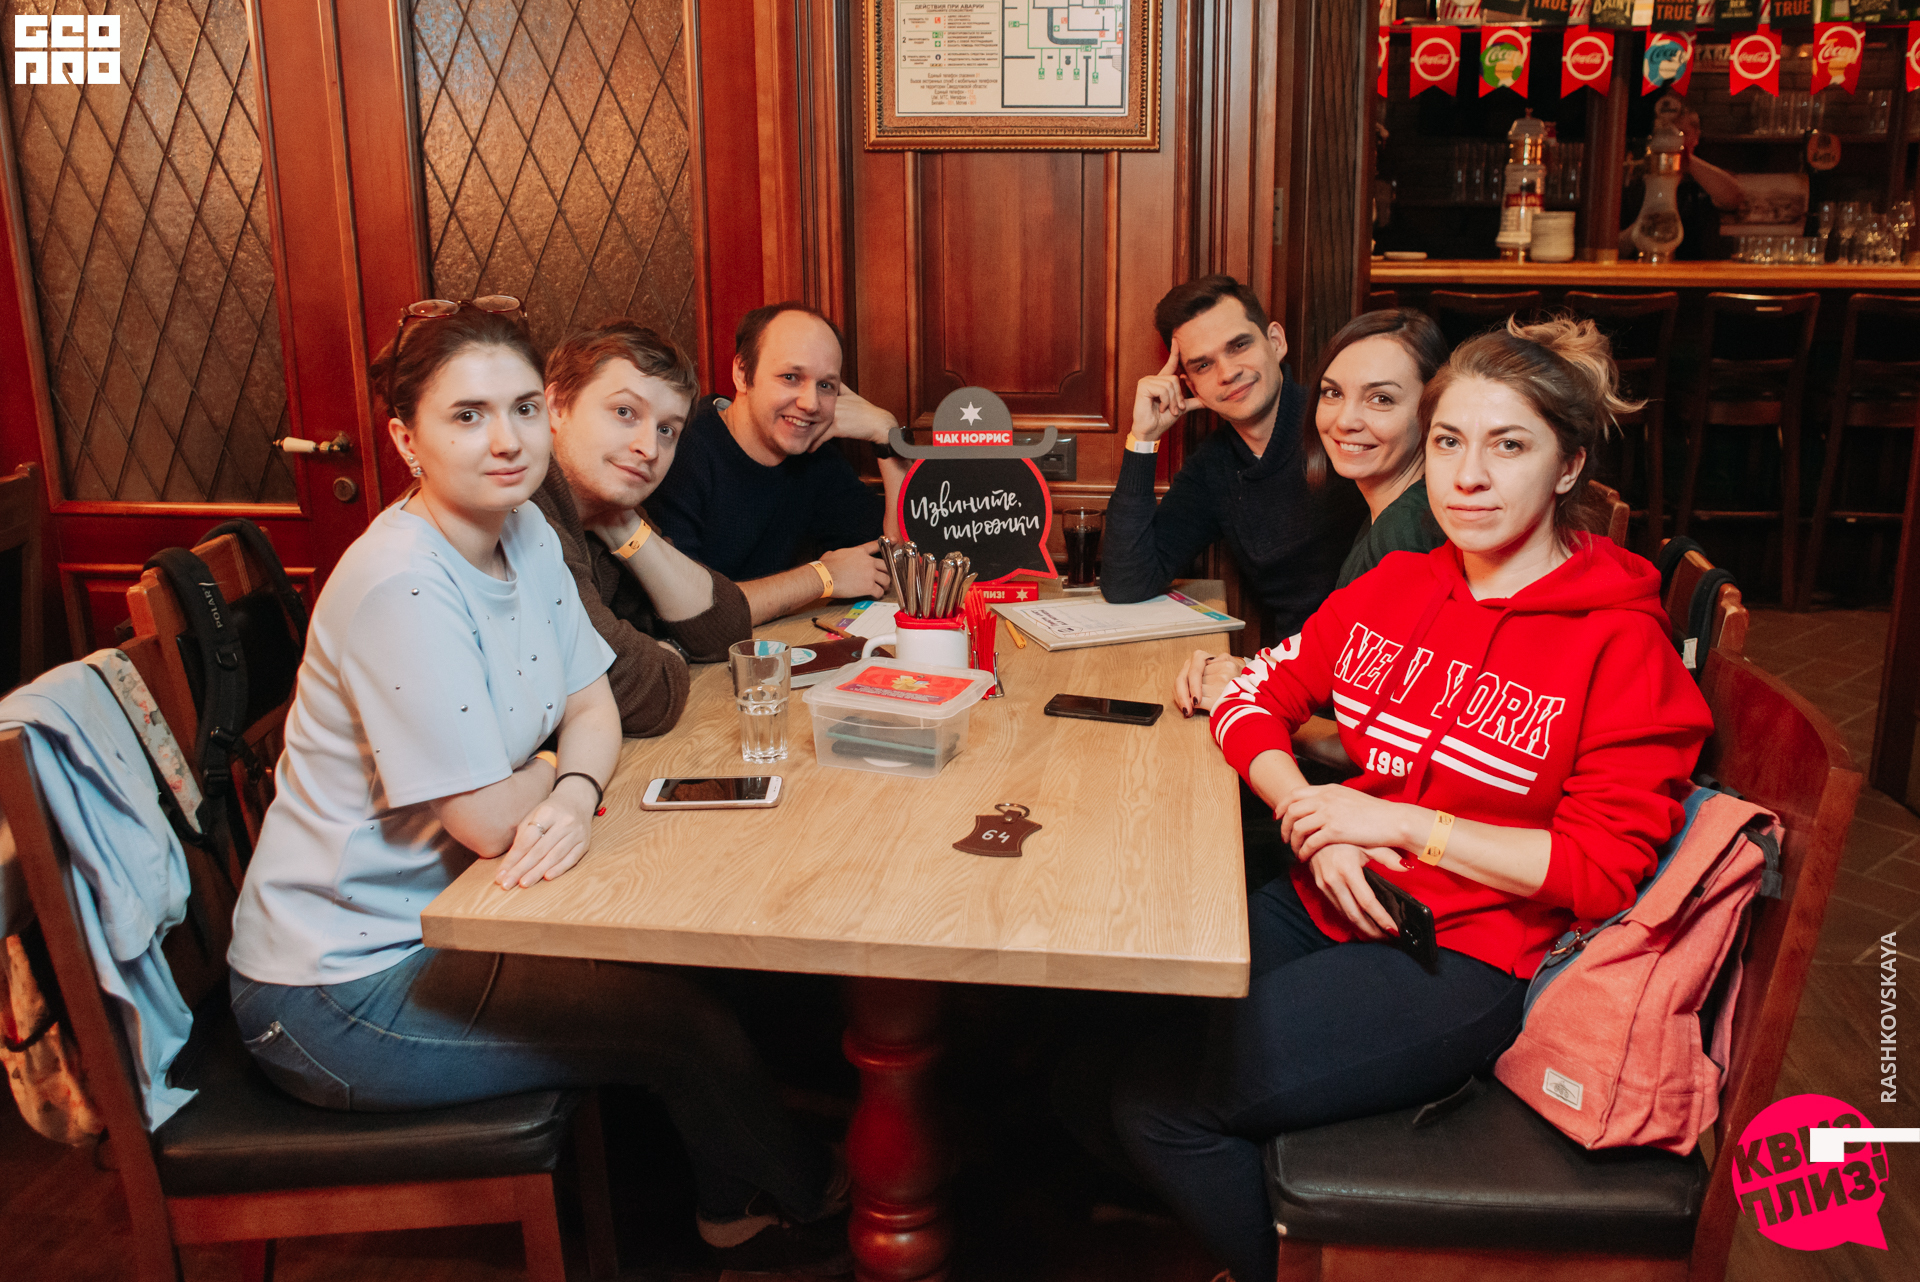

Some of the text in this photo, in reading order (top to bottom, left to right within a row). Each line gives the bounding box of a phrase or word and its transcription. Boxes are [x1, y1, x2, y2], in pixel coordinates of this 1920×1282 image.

[1657, 4, 1693, 20] TRUE
[935, 433, 1010, 444] ЧАК НОРРИС
[910, 480, 1022, 527] Извините,
[944, 515, 1040, 543] пирожки
[204, 590, 223, 628] POLAR
[1430, 659, 1566, 760] YORK
[982, 829, 1010, 844] 64
